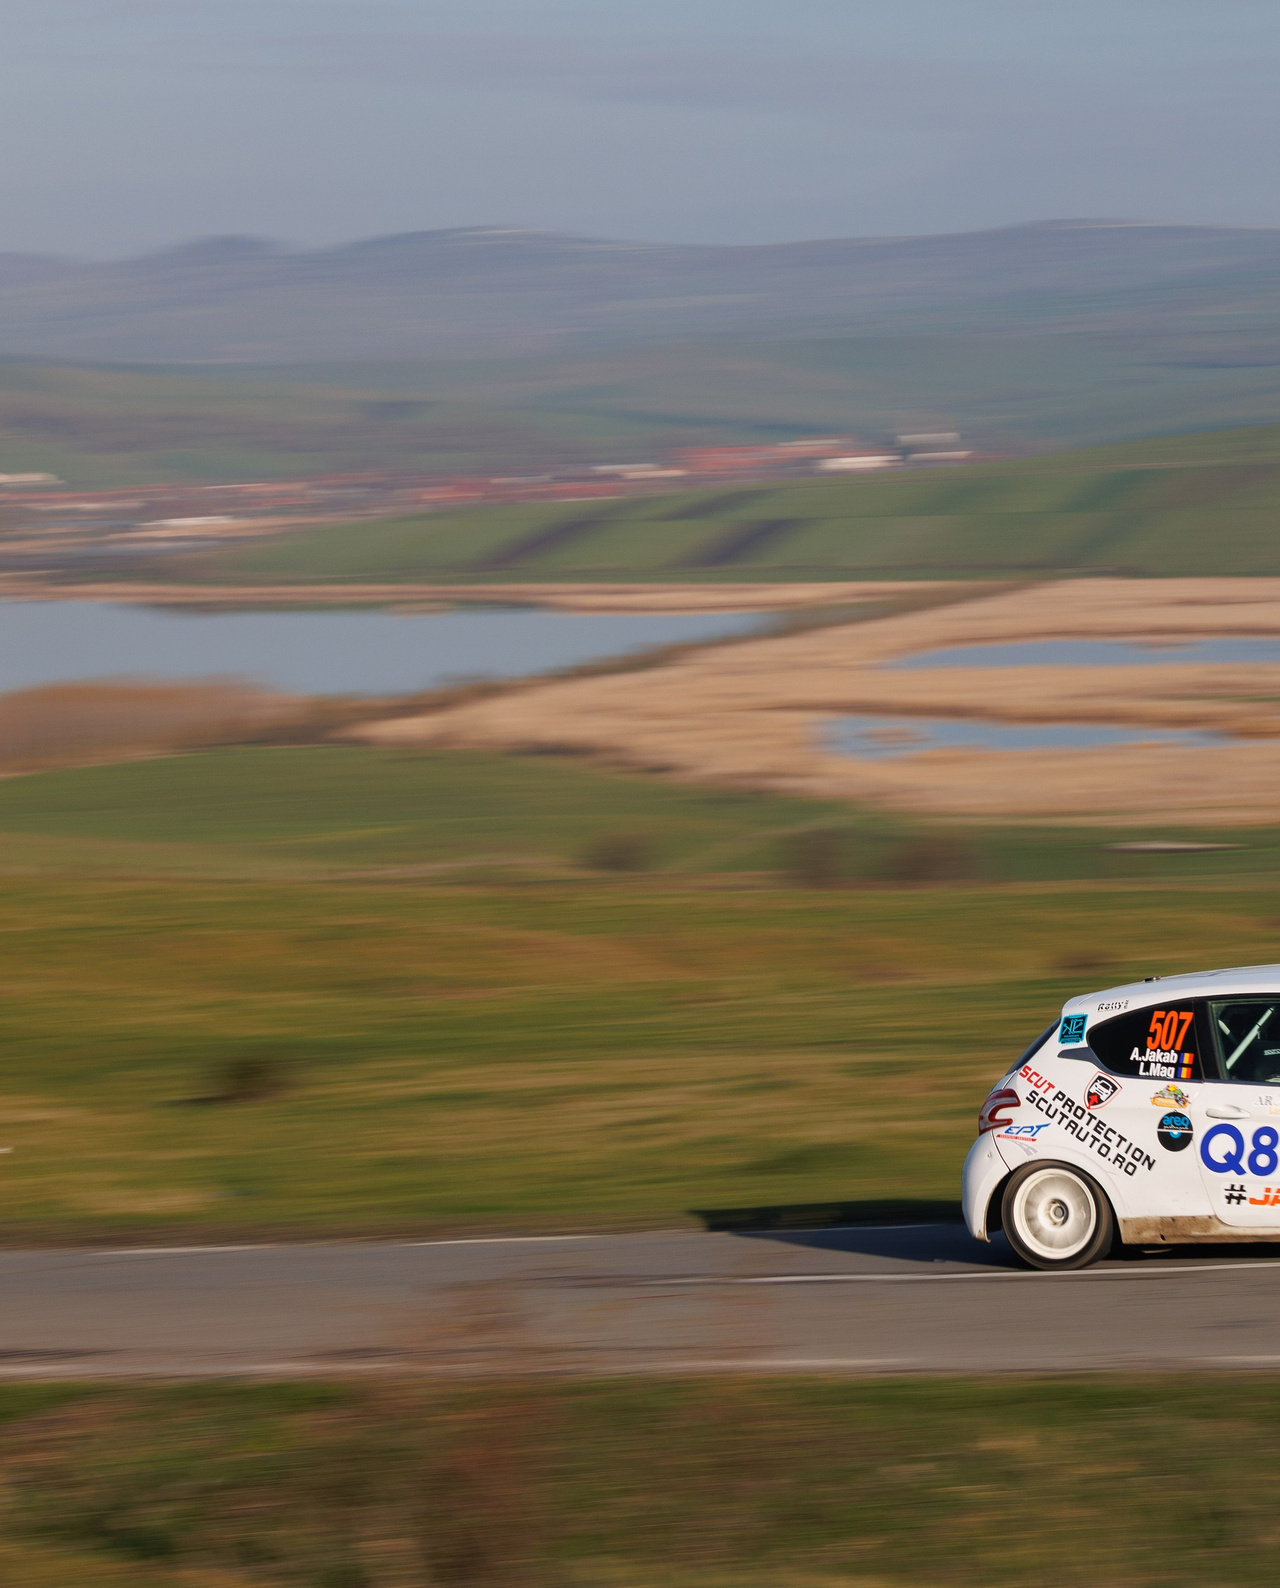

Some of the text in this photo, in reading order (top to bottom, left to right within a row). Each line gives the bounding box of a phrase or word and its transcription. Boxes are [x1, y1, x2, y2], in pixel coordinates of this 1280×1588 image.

[1146, 1010, 1194, 1050] 507
[1129, 1046, 1179, 1064] A.Jakab
[1004, 1122, 1051, 1137] EPT
[1019, 1065, 1156, 1171] SCUT PROTECTION
[1025, 1090, 1138, 1176] SCUTAUTO.RO
[1200, 1123, 1279, 1177] Q8
